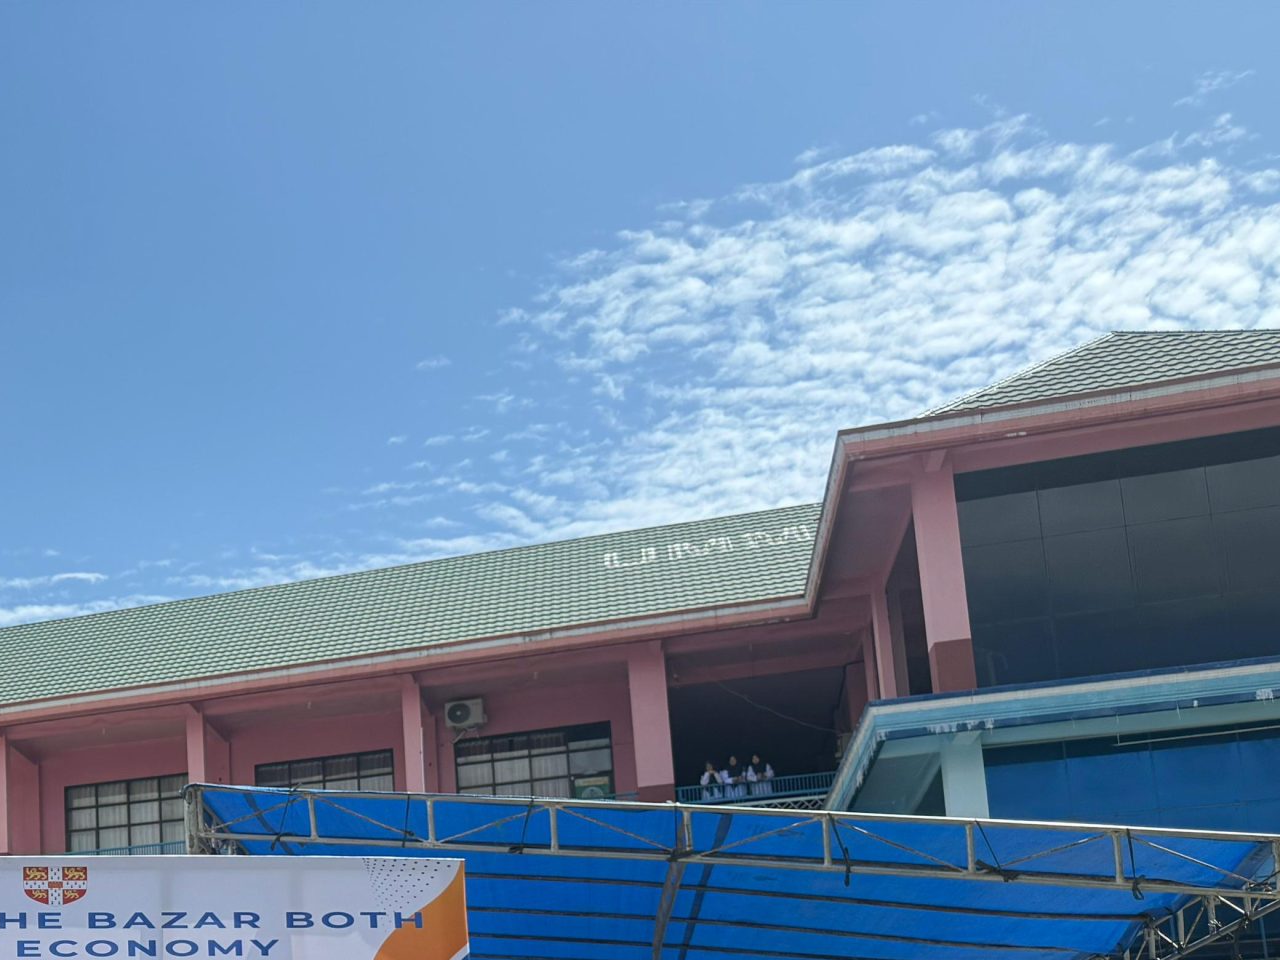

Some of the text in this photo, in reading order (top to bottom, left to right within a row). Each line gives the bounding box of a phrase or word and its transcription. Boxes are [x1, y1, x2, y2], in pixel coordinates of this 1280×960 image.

[88, 911, 261, 930] BAZAR
[286, 910, 424, 929] BOTH
[17, 939, 280, 958] ECONOMY
